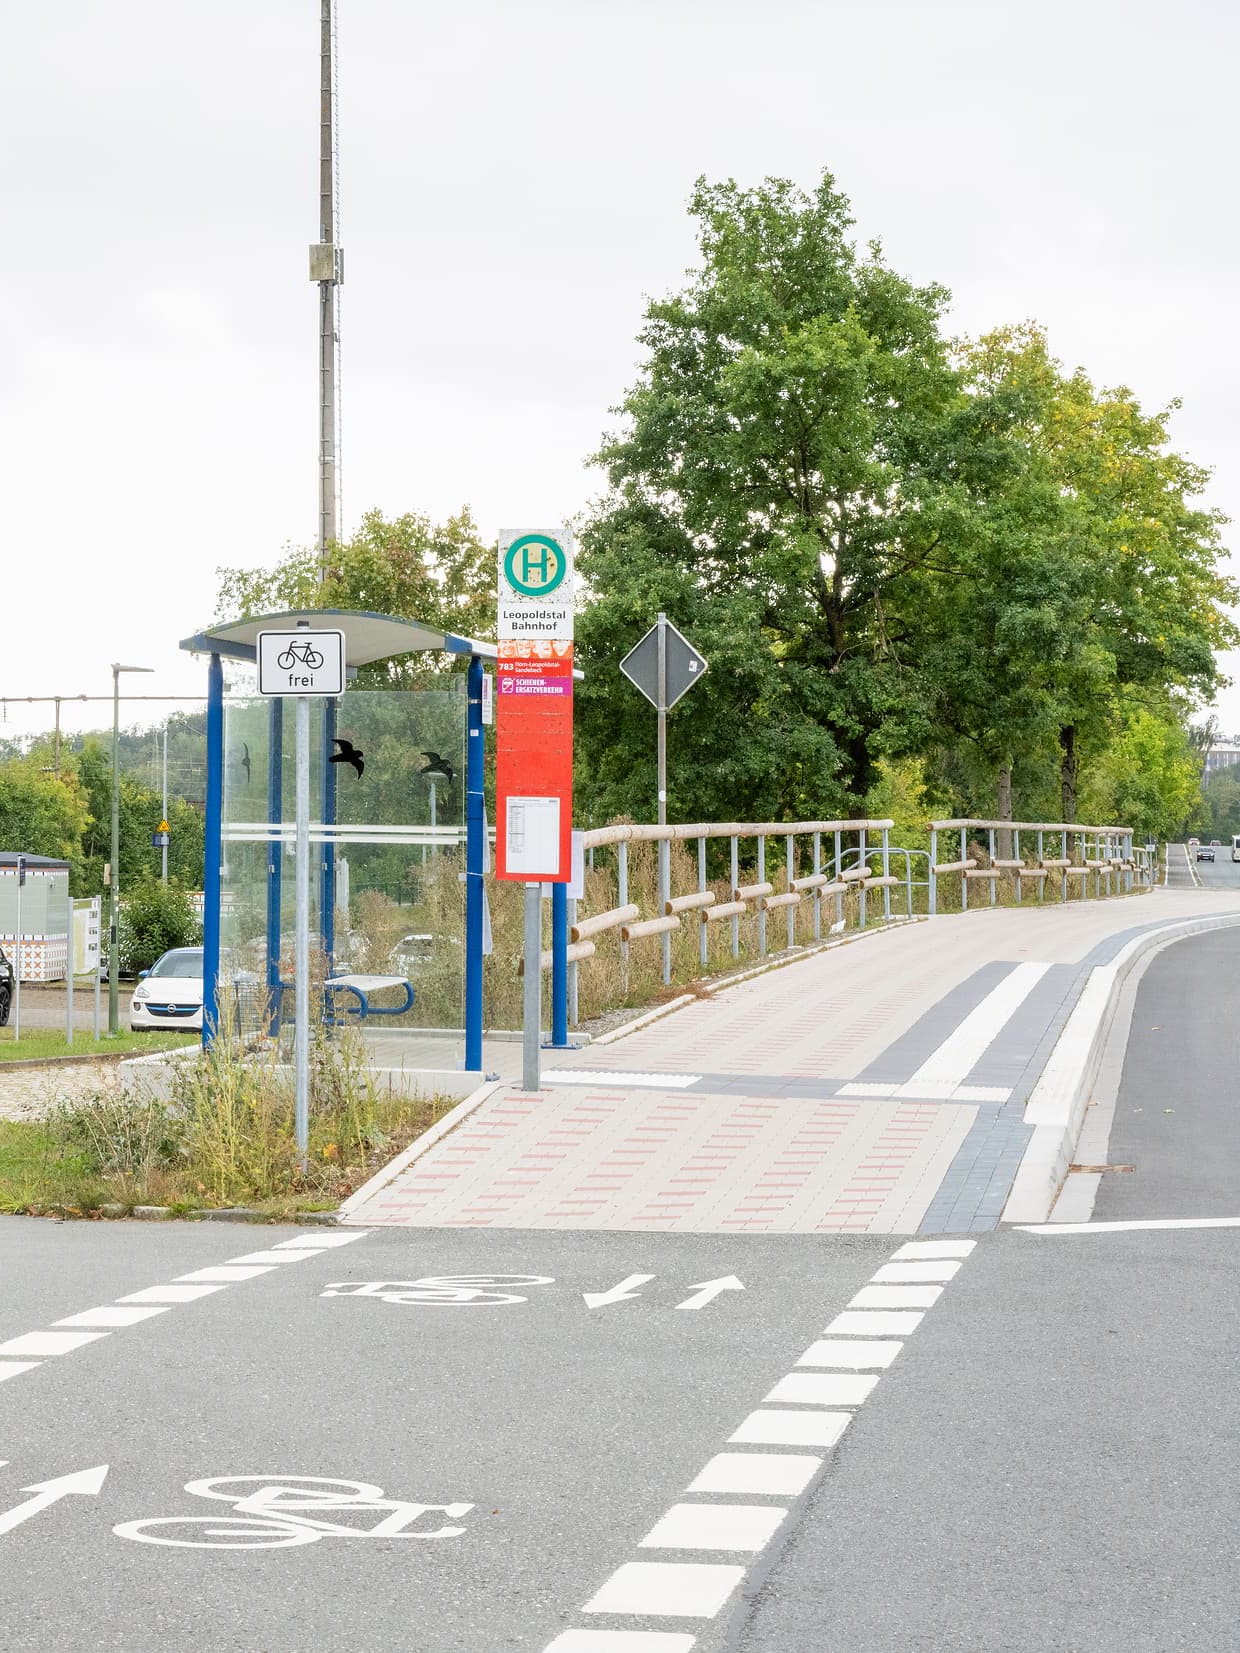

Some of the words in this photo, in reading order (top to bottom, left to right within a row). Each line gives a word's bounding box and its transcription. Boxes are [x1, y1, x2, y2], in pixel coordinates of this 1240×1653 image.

[522, 549, 547, 582] H
[503, 611, 566, 620] Leopoldstal
[511, 622, 558, 630] Bahnhof
[288, 673, 314, 687] frei
